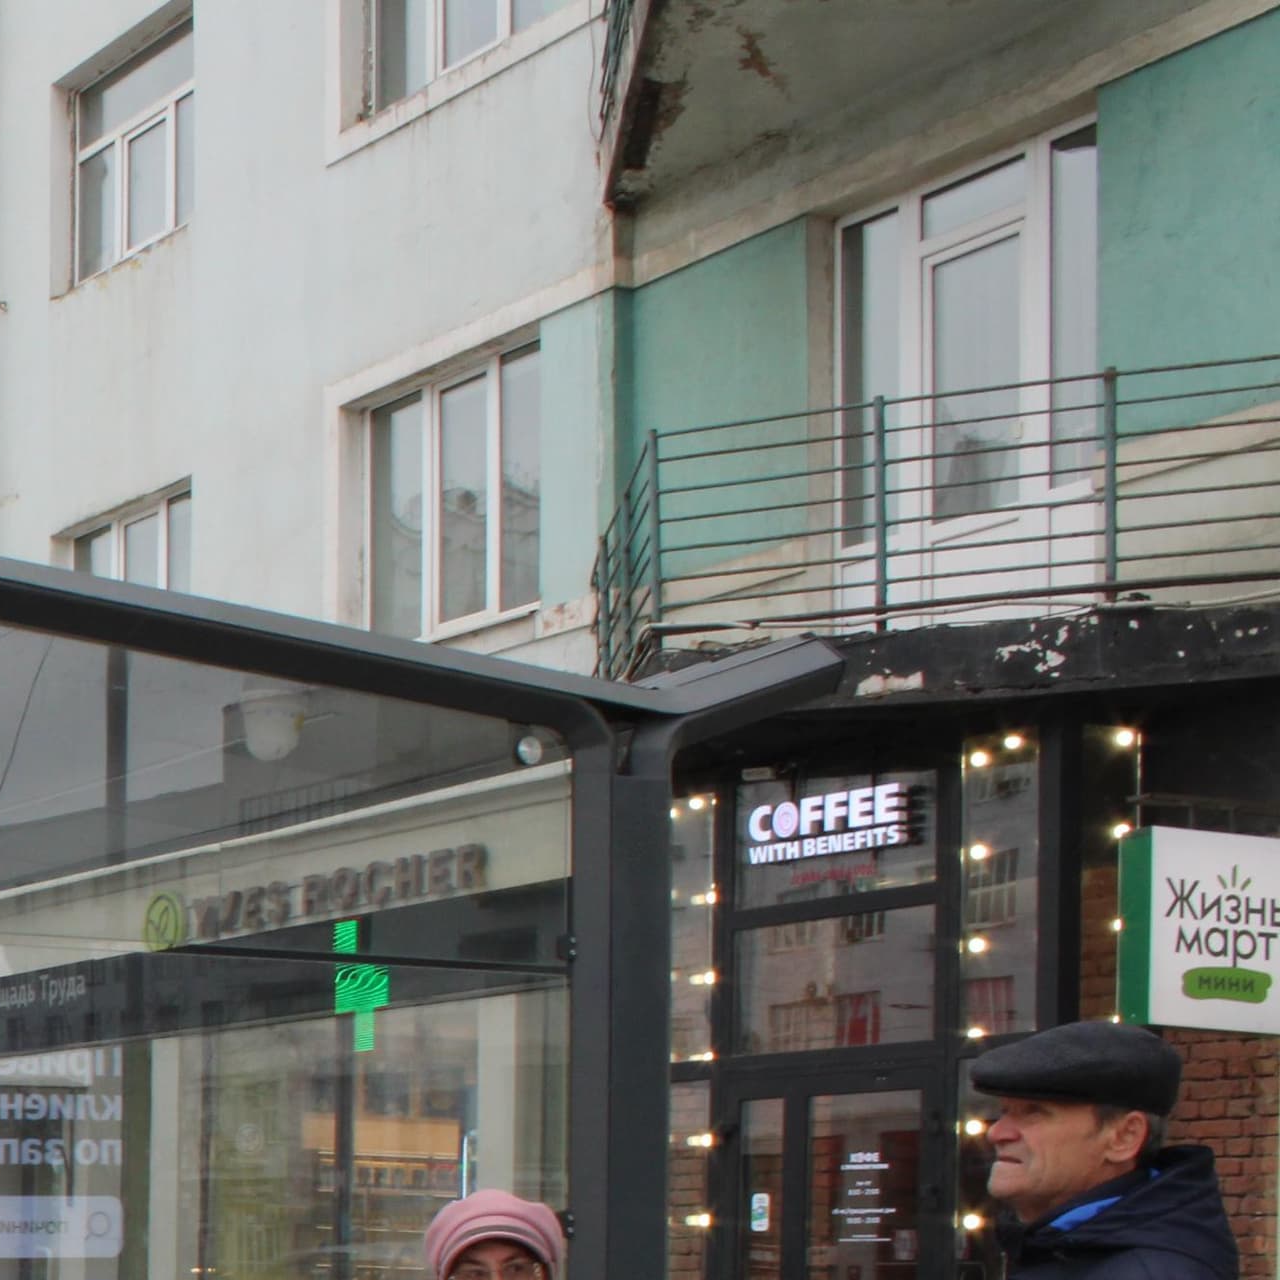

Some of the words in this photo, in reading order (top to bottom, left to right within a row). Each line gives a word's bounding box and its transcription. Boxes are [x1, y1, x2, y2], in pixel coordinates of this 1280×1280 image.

[748, 782, 904, 842] COFFEE
[749, 840, 800, 865] WITH
[802, 824, 906, 857] BENEFITS
[192, 880, 291, 939] YVES
[301, 843, 488, 916] ROCHER
[1175, 925, 1278, 968] март
[39, 973, 86, 1009] Труда
